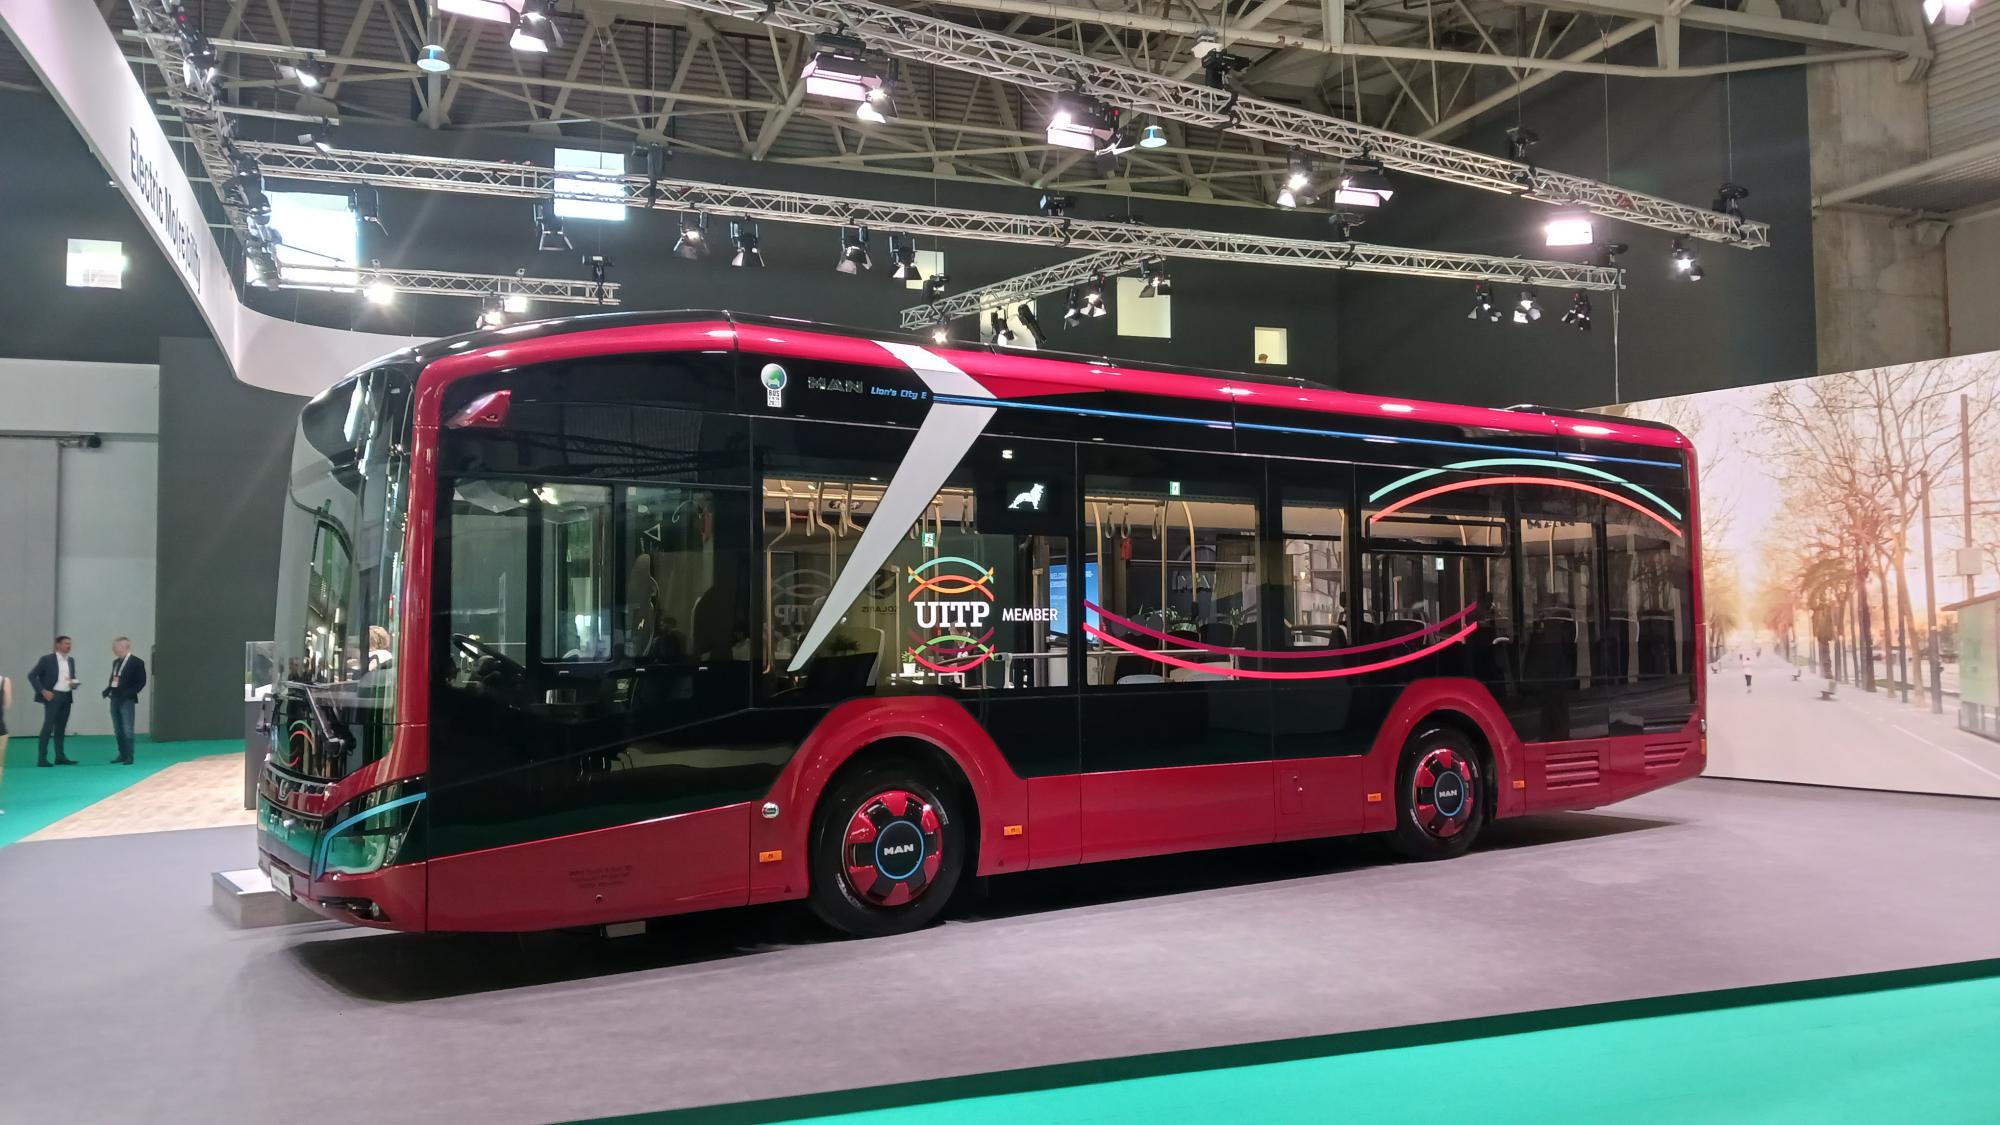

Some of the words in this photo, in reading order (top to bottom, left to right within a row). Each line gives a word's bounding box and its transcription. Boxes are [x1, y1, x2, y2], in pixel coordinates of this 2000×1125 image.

[130, 126, 164, 225] Electric
[808, 377, 863, 393] MAN
[871, 387, 897, 397] Lion's
[901, 390, 918, 400] City
[914, 601, 990, 628] UITP
[1002, 608, 1058, 622] MEMBER
[1439, 790, 1457, 798] MAN
[883, 843, 914, 856] MAN
